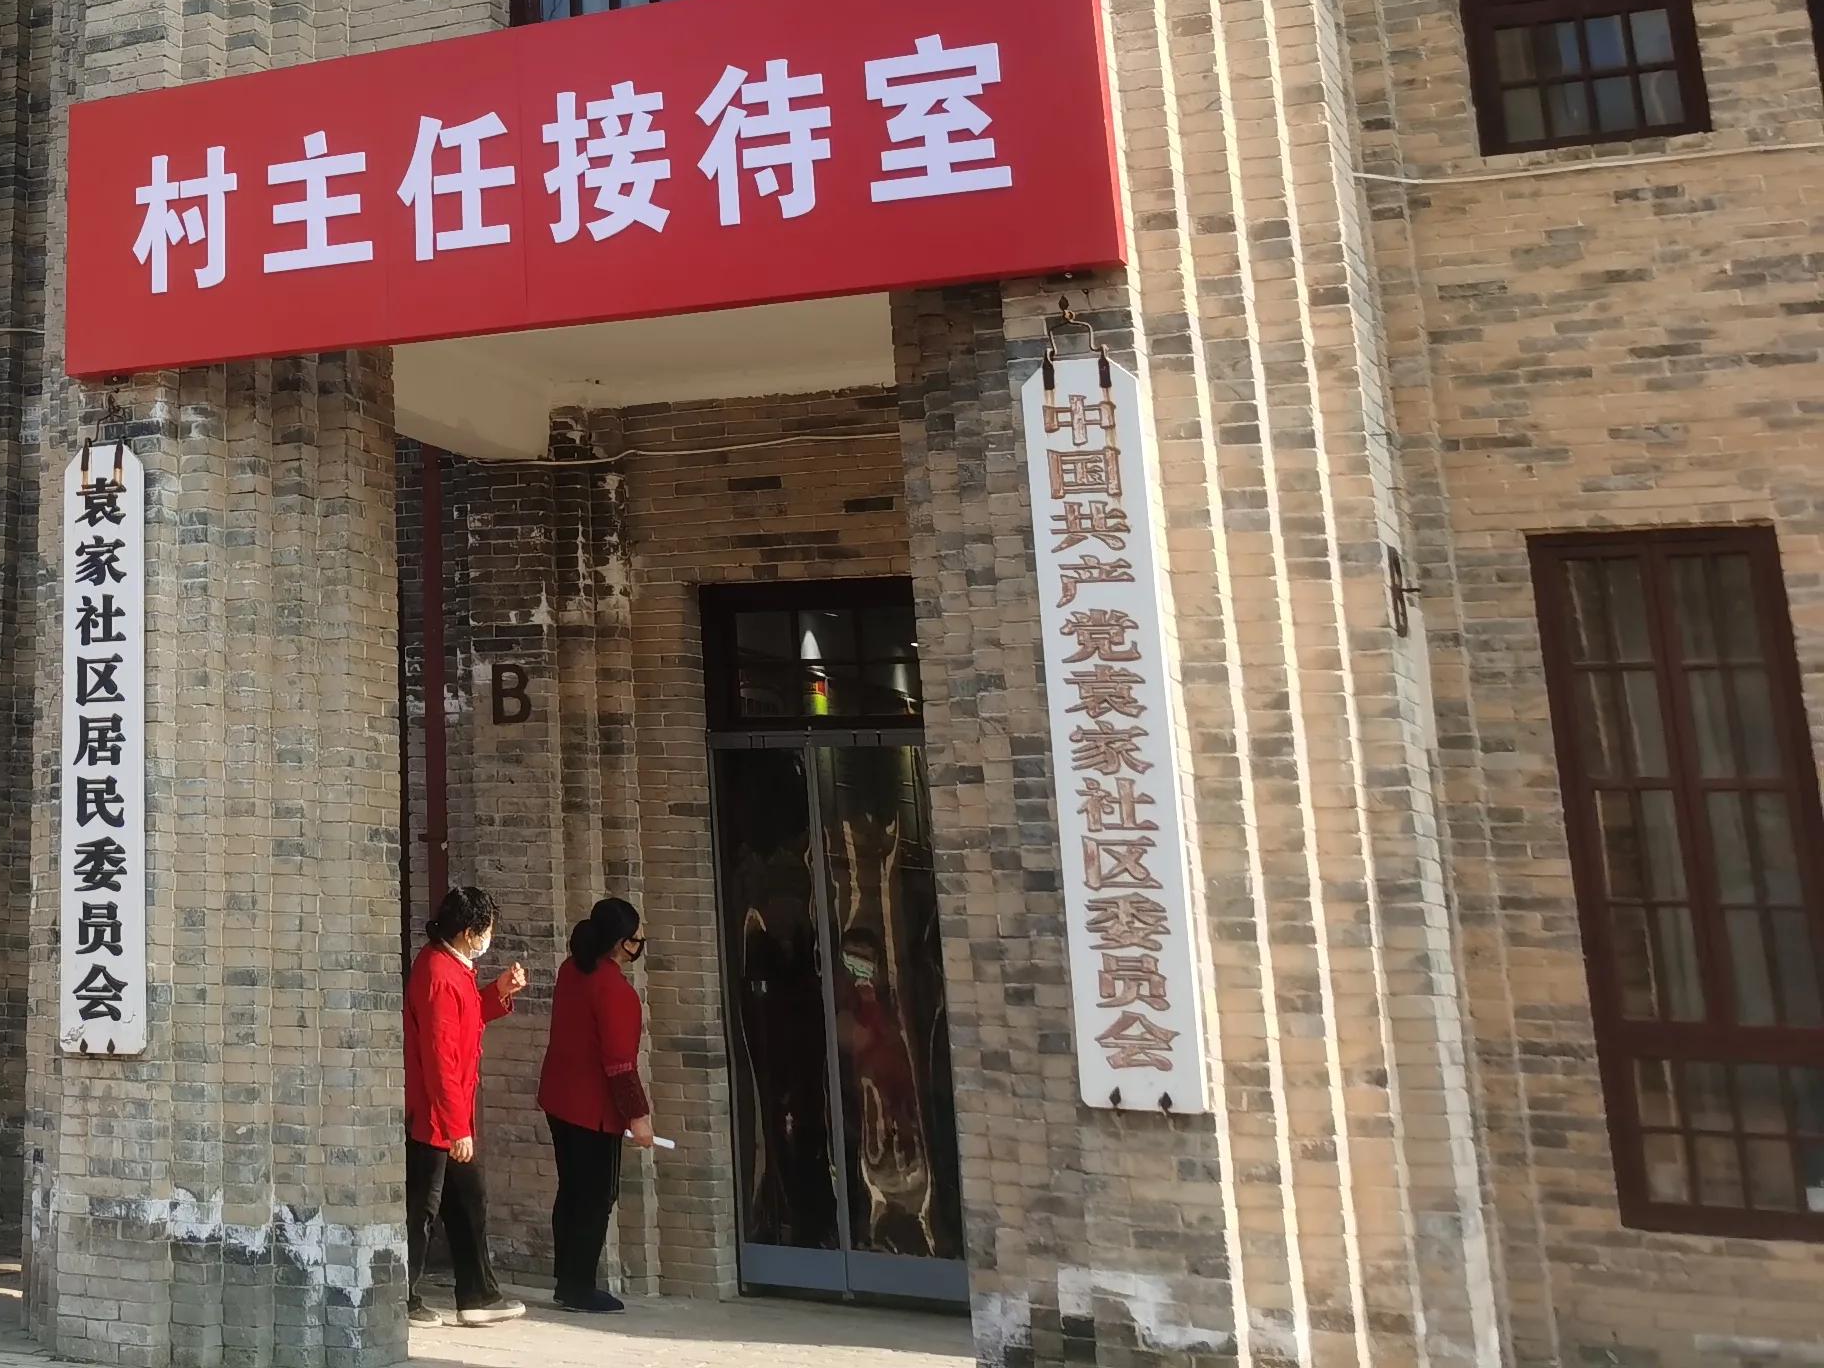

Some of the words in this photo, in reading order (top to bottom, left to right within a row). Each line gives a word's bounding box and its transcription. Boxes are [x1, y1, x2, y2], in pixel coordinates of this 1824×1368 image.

[132, 33, 1014, 294] 村主任接待室
[72, 476, 129, 1026] 袁家社区居民委员会
[491, 663, 531, 725] B
[1042, 393, 1182, 1074] 中国共产党袁家社区委员会
